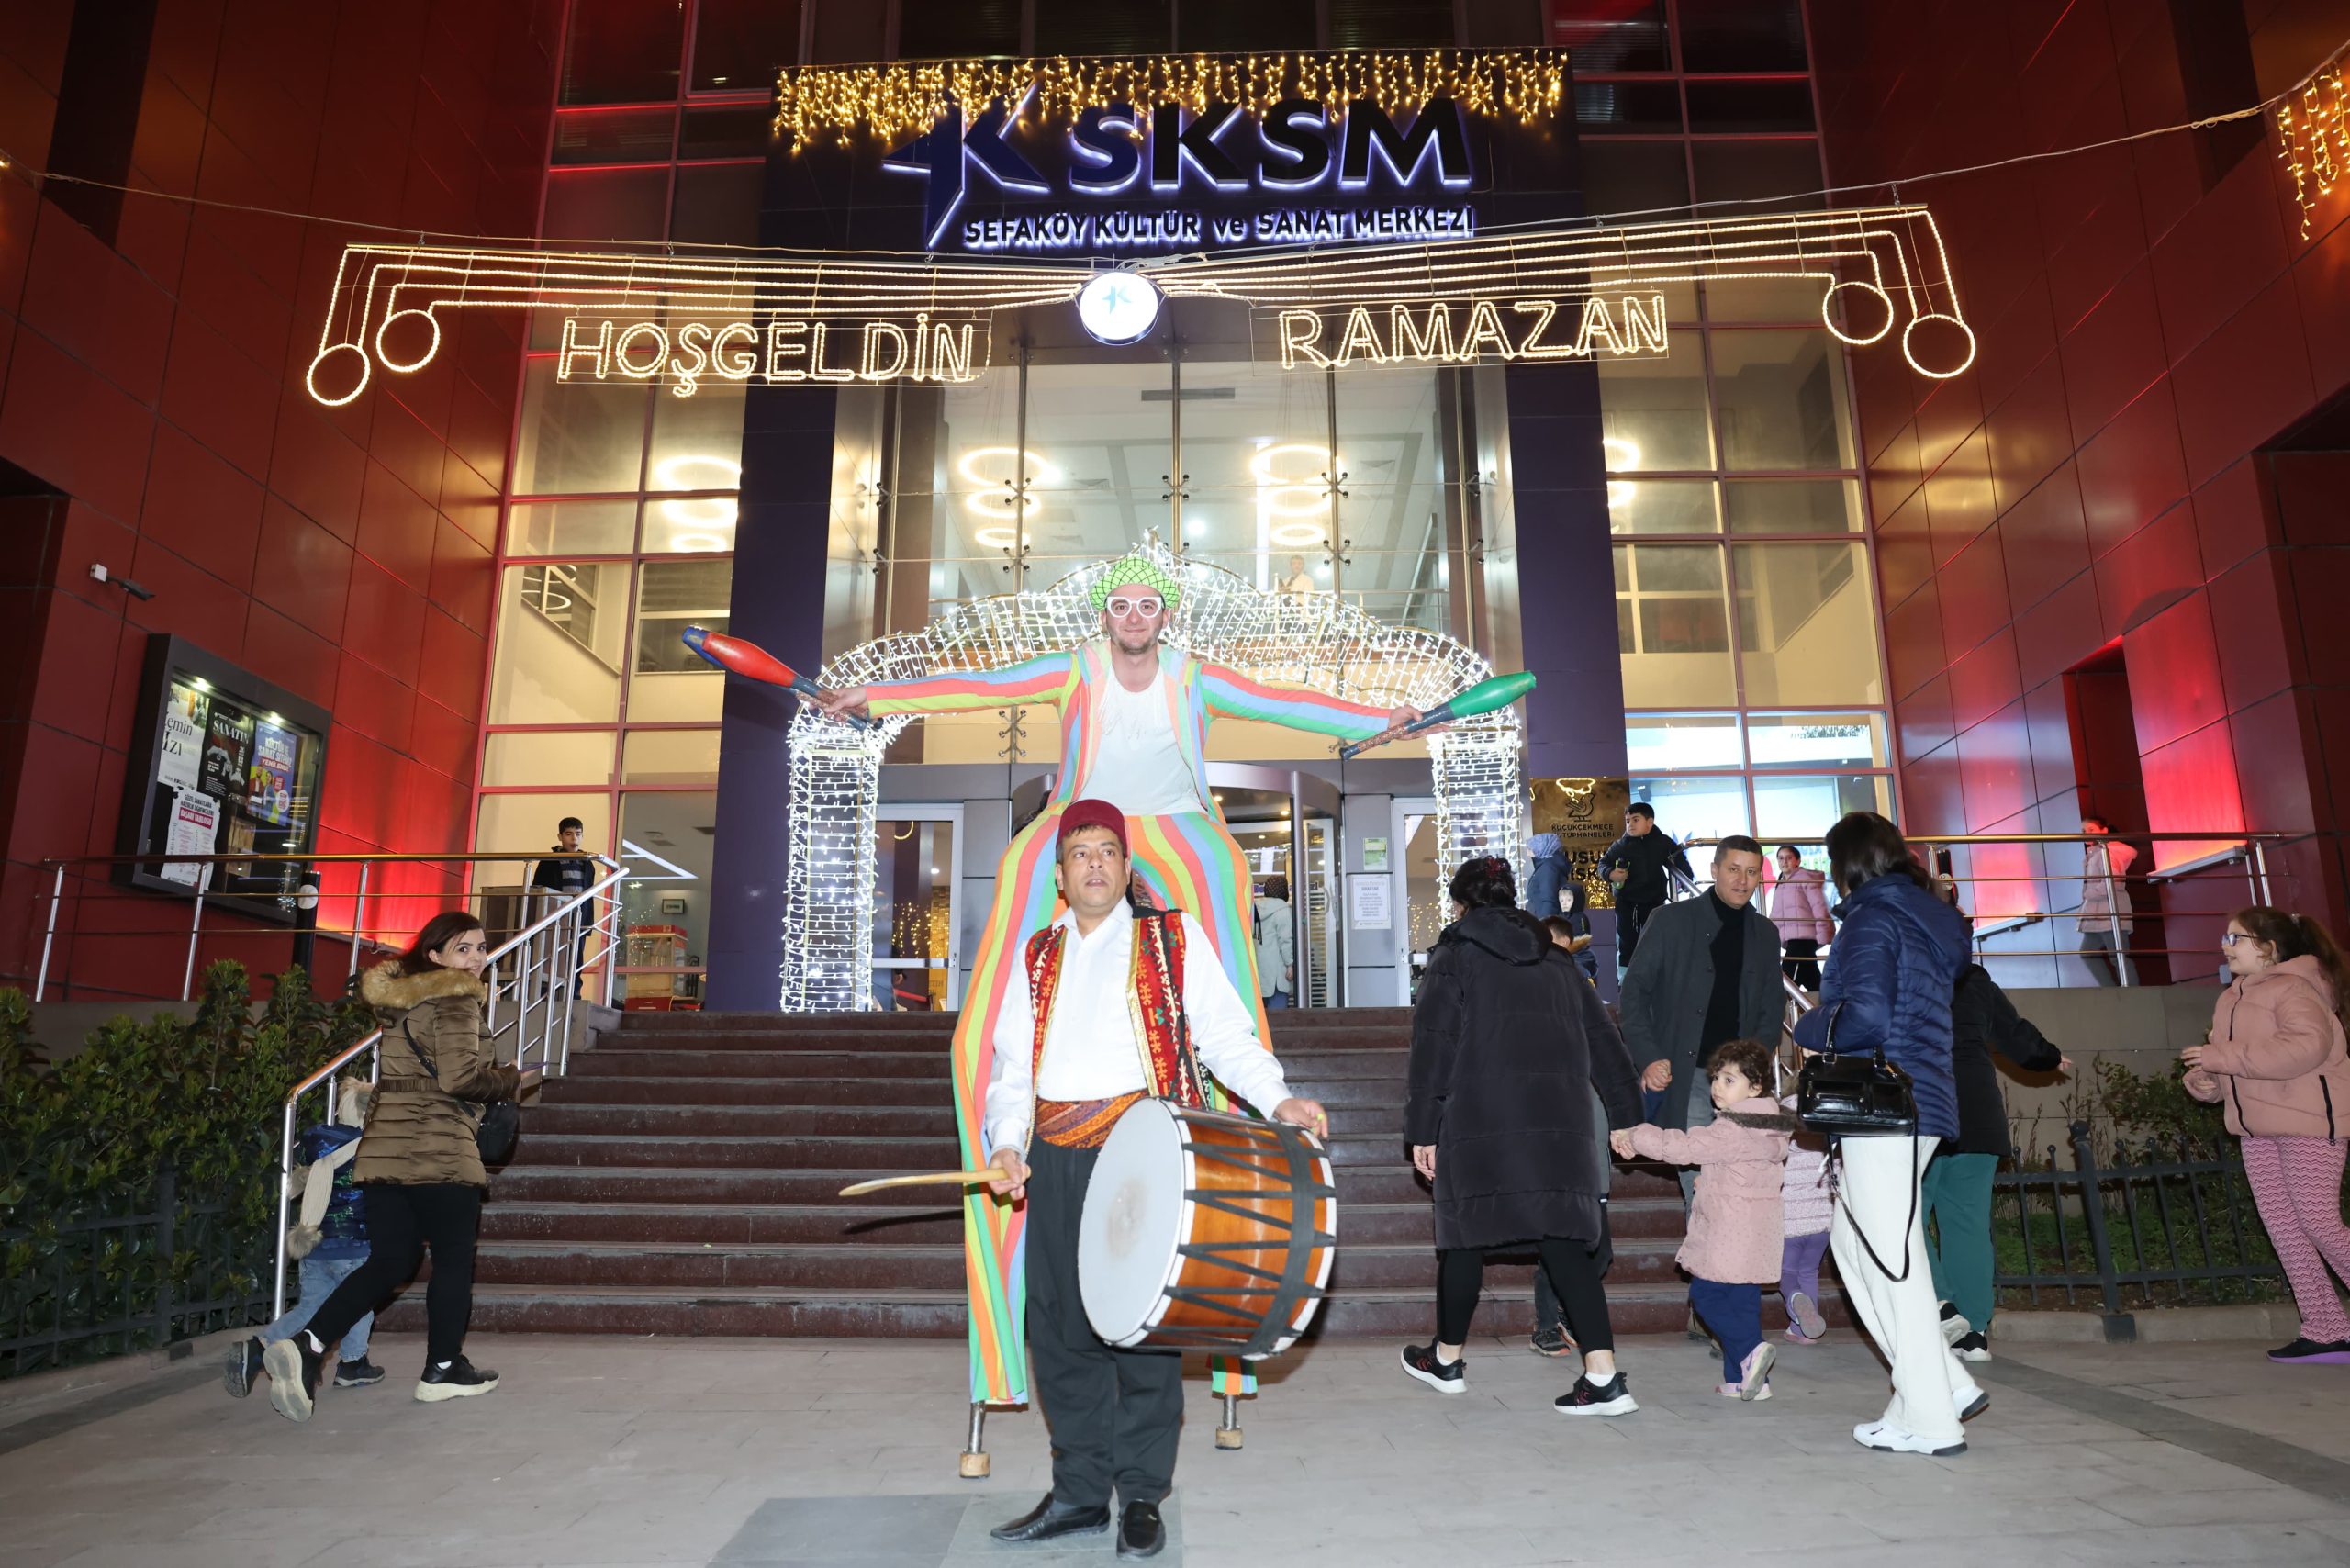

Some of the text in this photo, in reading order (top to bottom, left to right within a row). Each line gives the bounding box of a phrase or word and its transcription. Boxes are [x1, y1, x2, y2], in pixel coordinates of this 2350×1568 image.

[964, 209, 1089, 244] SEFAKÖY
[1094, 208, 1200, 242] KÜLTÜR
[1214, 217, 1247, 241] ve
[1258, 207, 1346, 241] SANAT
[1279, 295, 1669, 369] RAMAZAN
